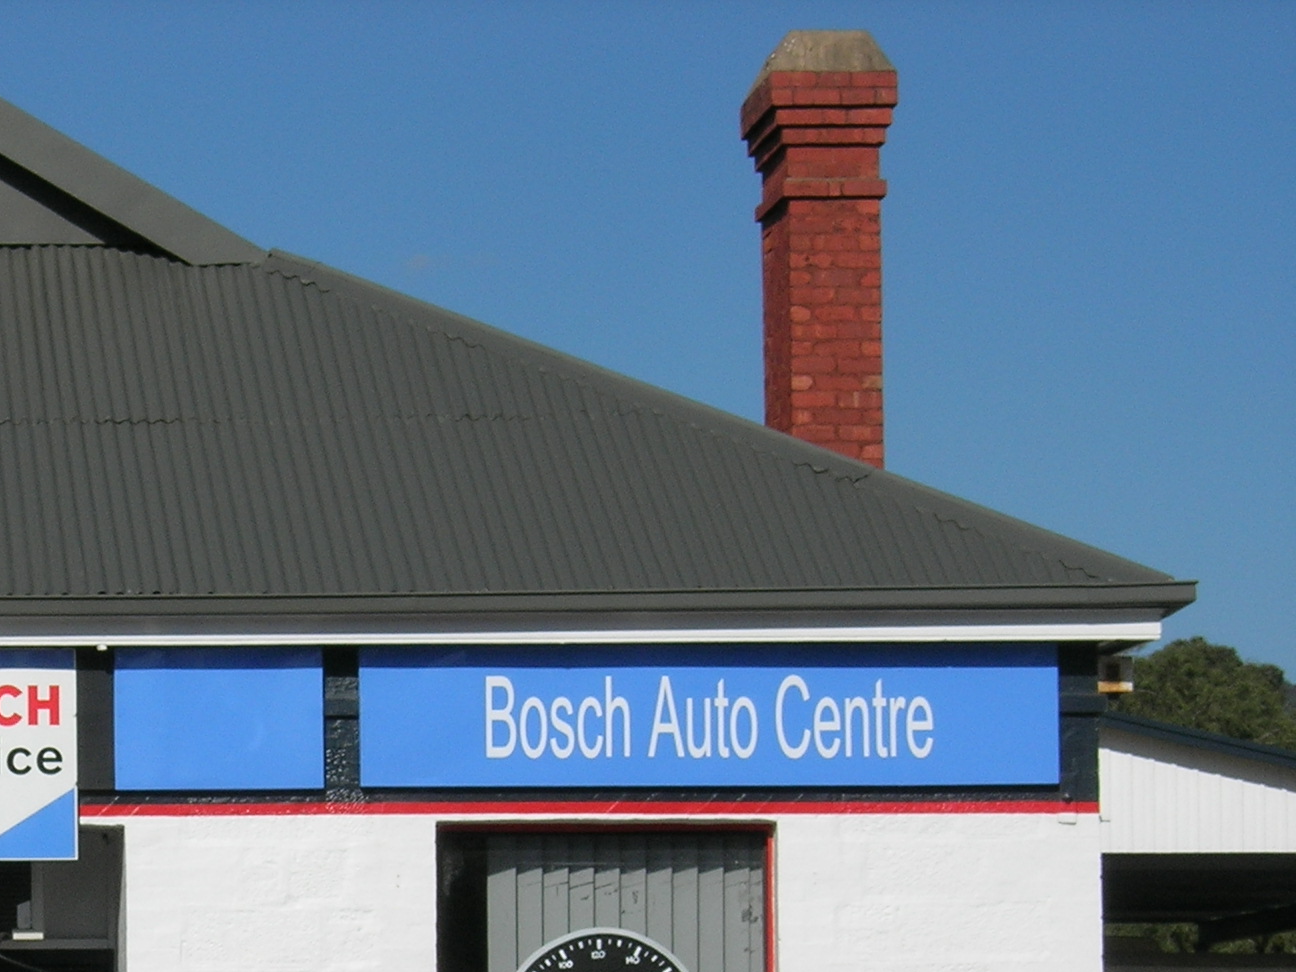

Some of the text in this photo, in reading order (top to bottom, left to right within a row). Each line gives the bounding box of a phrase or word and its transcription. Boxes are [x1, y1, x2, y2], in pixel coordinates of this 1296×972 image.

[484, 673, 935, 760] Bosch Auto Centre
[558, 960, 574, 970] 100
[625, 956, 641, 966] 140
